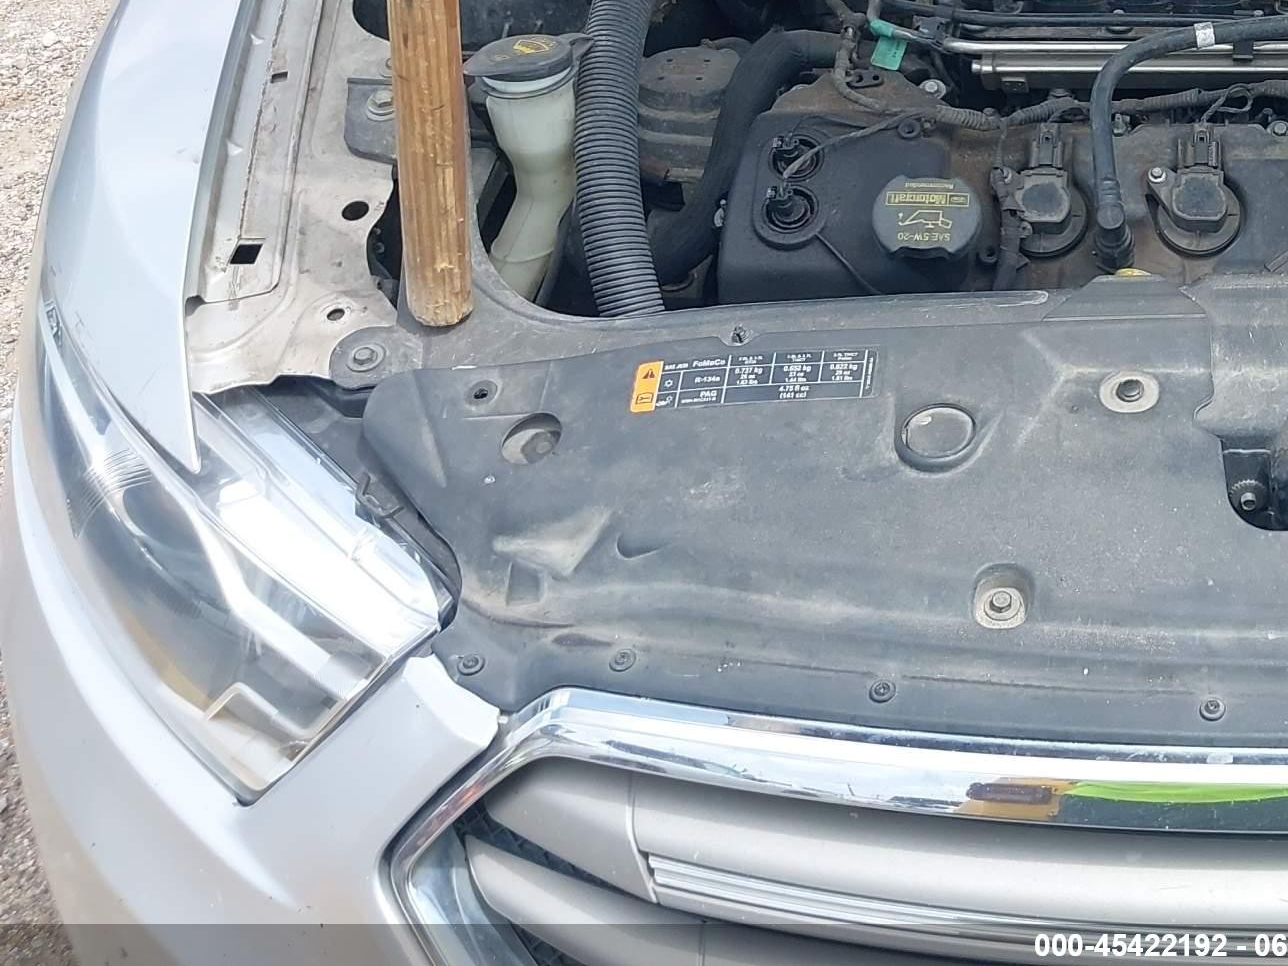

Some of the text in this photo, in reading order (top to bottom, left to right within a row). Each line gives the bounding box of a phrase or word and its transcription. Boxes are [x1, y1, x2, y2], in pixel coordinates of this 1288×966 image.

[890, 192, 947, 205] Motorcraft
[897, 232, 951, 242] SAE 5W-20
[692, 358, 726, 368] FoMoCo
[753, 366, 764, 375] kg
[802, 364, 812, 372] kg
[694, 375, 721, 383] R-134a
[699, 390, 717, 398] PAG
